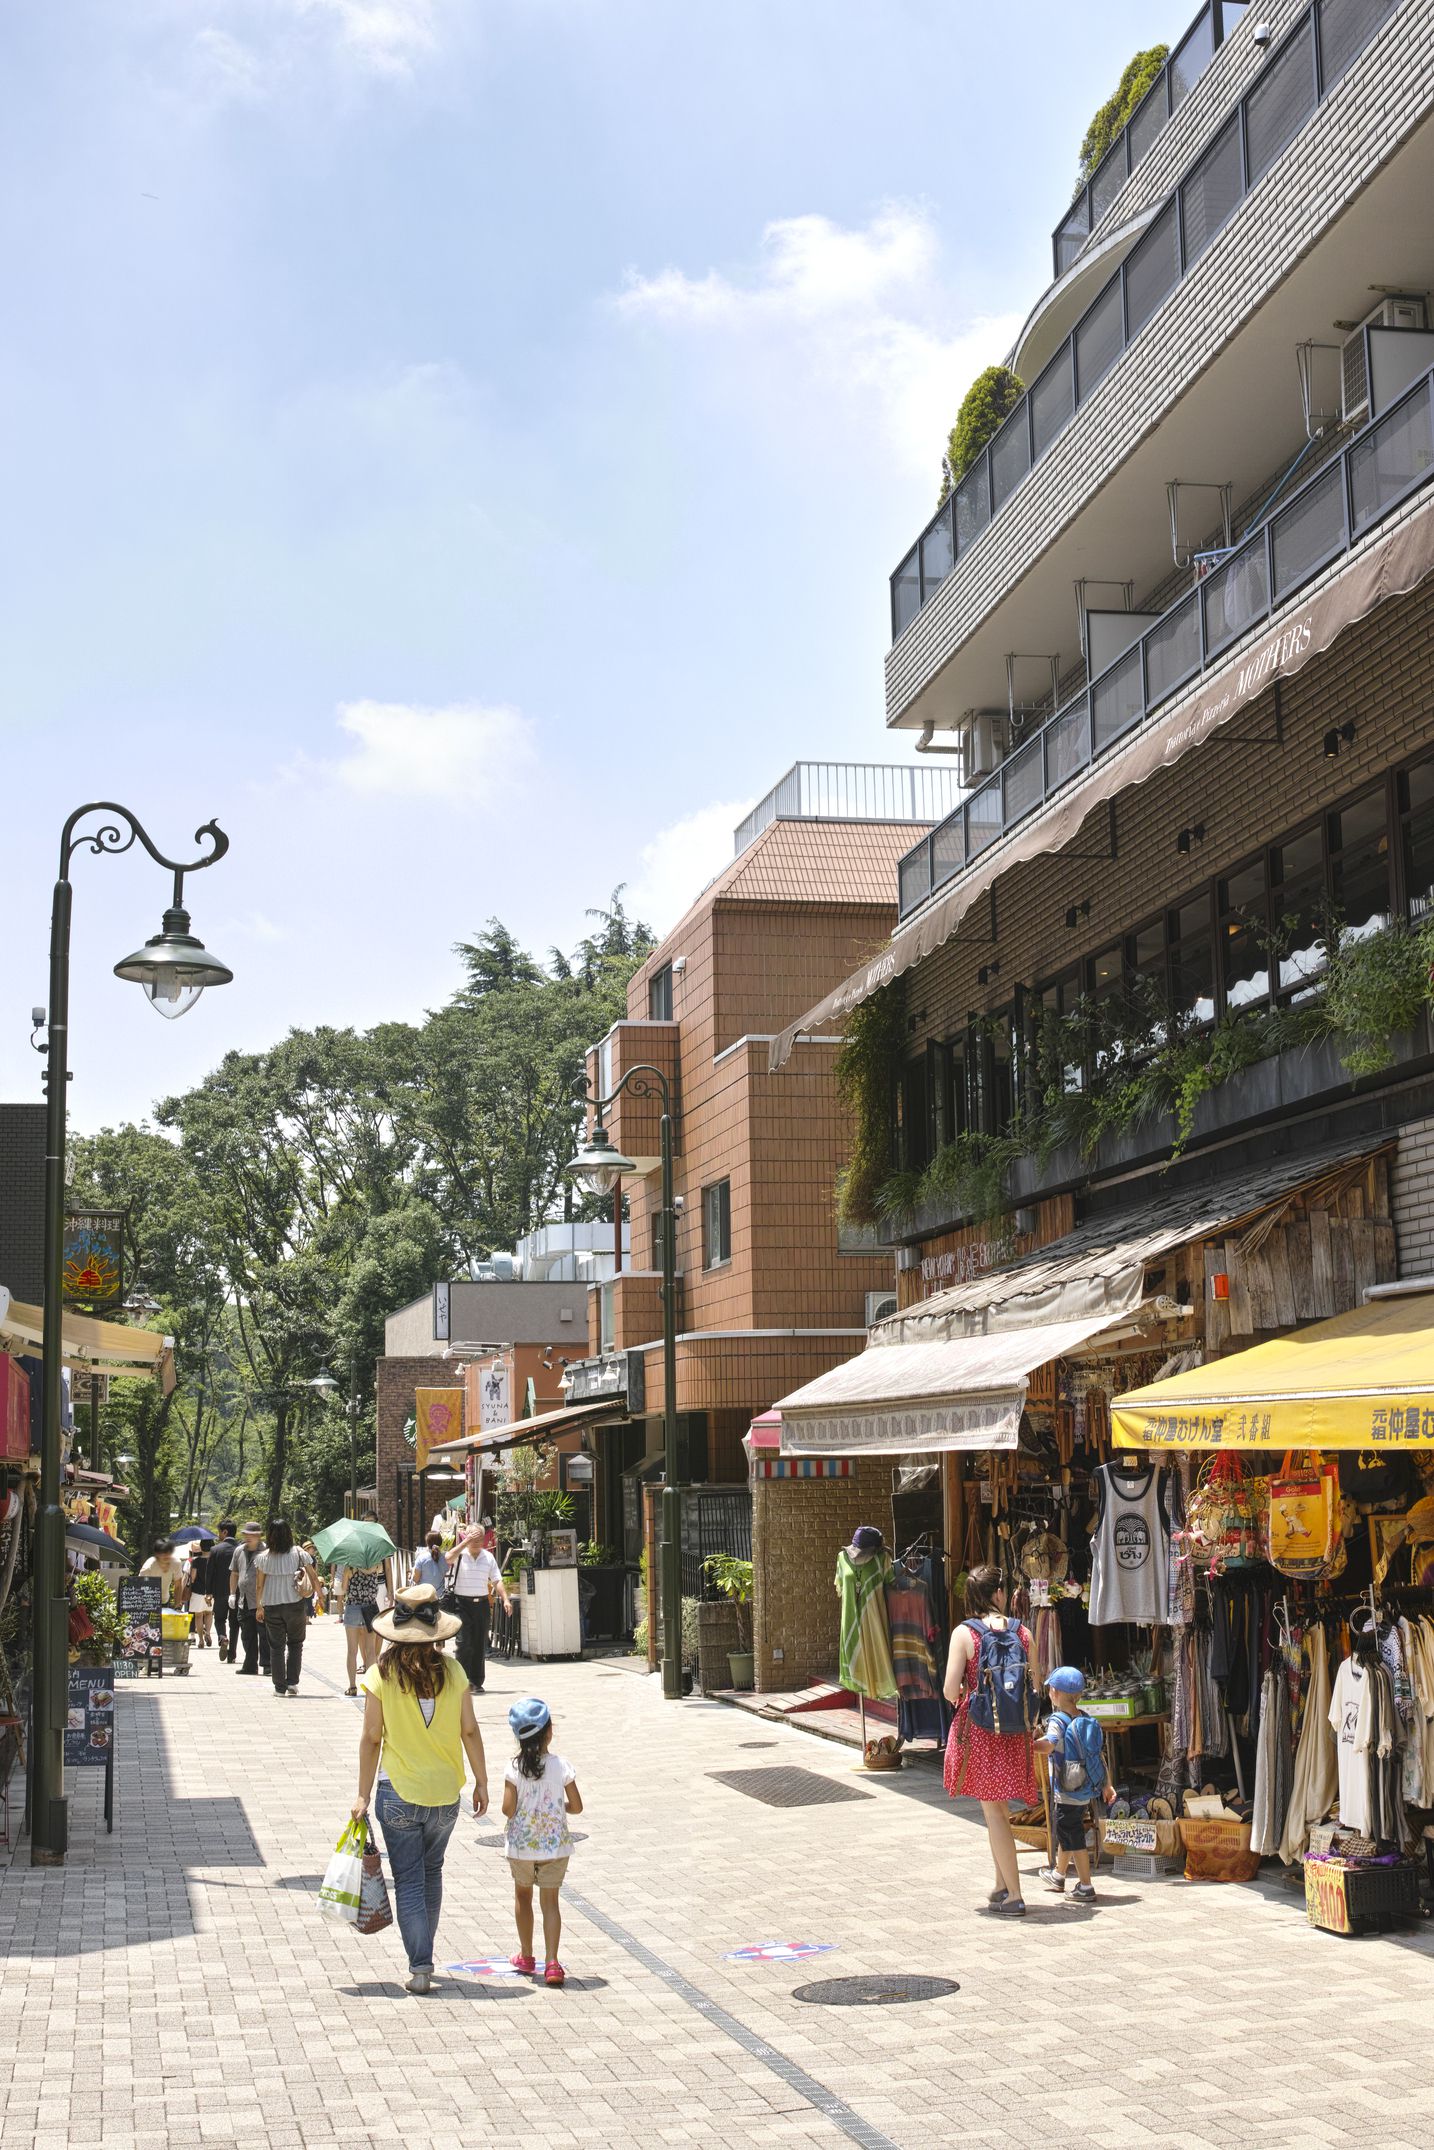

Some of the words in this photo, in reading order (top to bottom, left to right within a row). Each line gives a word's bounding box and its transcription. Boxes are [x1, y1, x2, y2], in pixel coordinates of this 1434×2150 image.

[1233, 617, 1312, 700] MOTHERS
[64, 1217, 120, 1231] 沖縄料理
[438, 1297, 446, 1324] いせや
[113, 1661, 133, 1670] 11:30
[114, 1670, 138, 1678] OPEN
[68, 1679, 105, 1690] MENU
